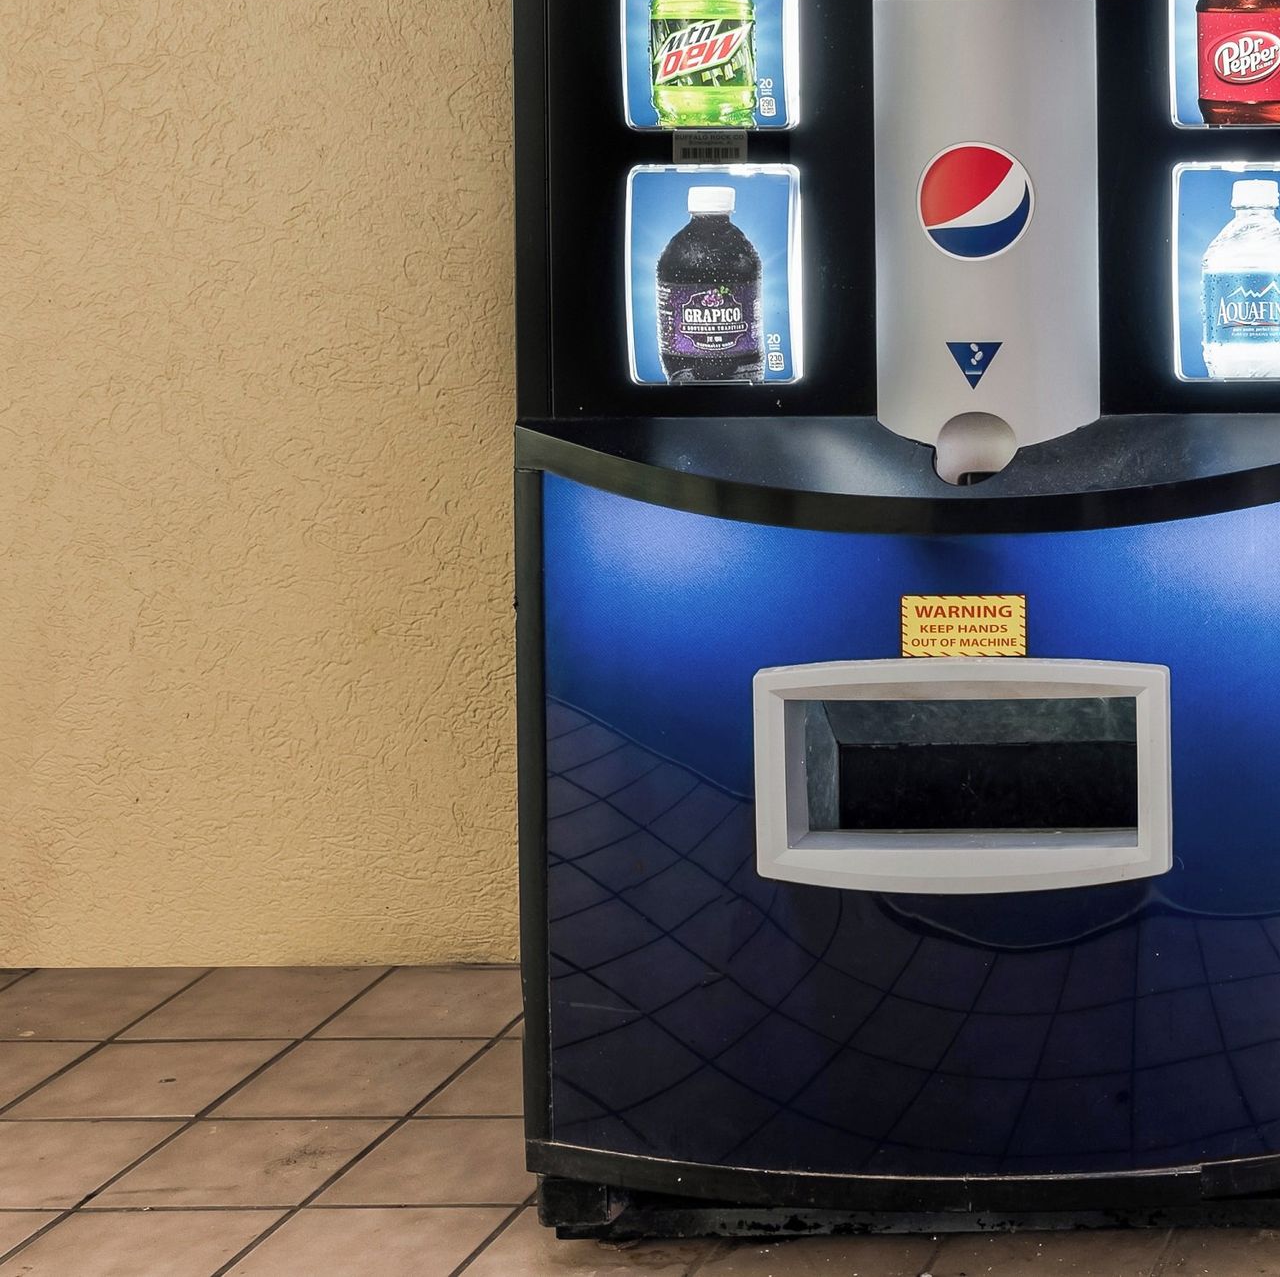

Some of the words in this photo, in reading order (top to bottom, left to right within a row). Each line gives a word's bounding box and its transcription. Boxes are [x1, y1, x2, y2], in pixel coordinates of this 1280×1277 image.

[1239, 37, 1263, 57] Dr
[1215, 42, 1278, 76] Pepper
[760, 78, 773, 88] 20
[685, 307, 740, 322] GRAPICO
[767, 334, 781, 344] 20
[915, 605, 1012, 618] WARNING
[920, 625, 954, 633] KEEP
[958, 625, 1008, 633] HANDS
[911, 638, 937, 647] OUT
[940, 638, 956, 647] OF
[960, 638, 1017, 647] MACHINE
